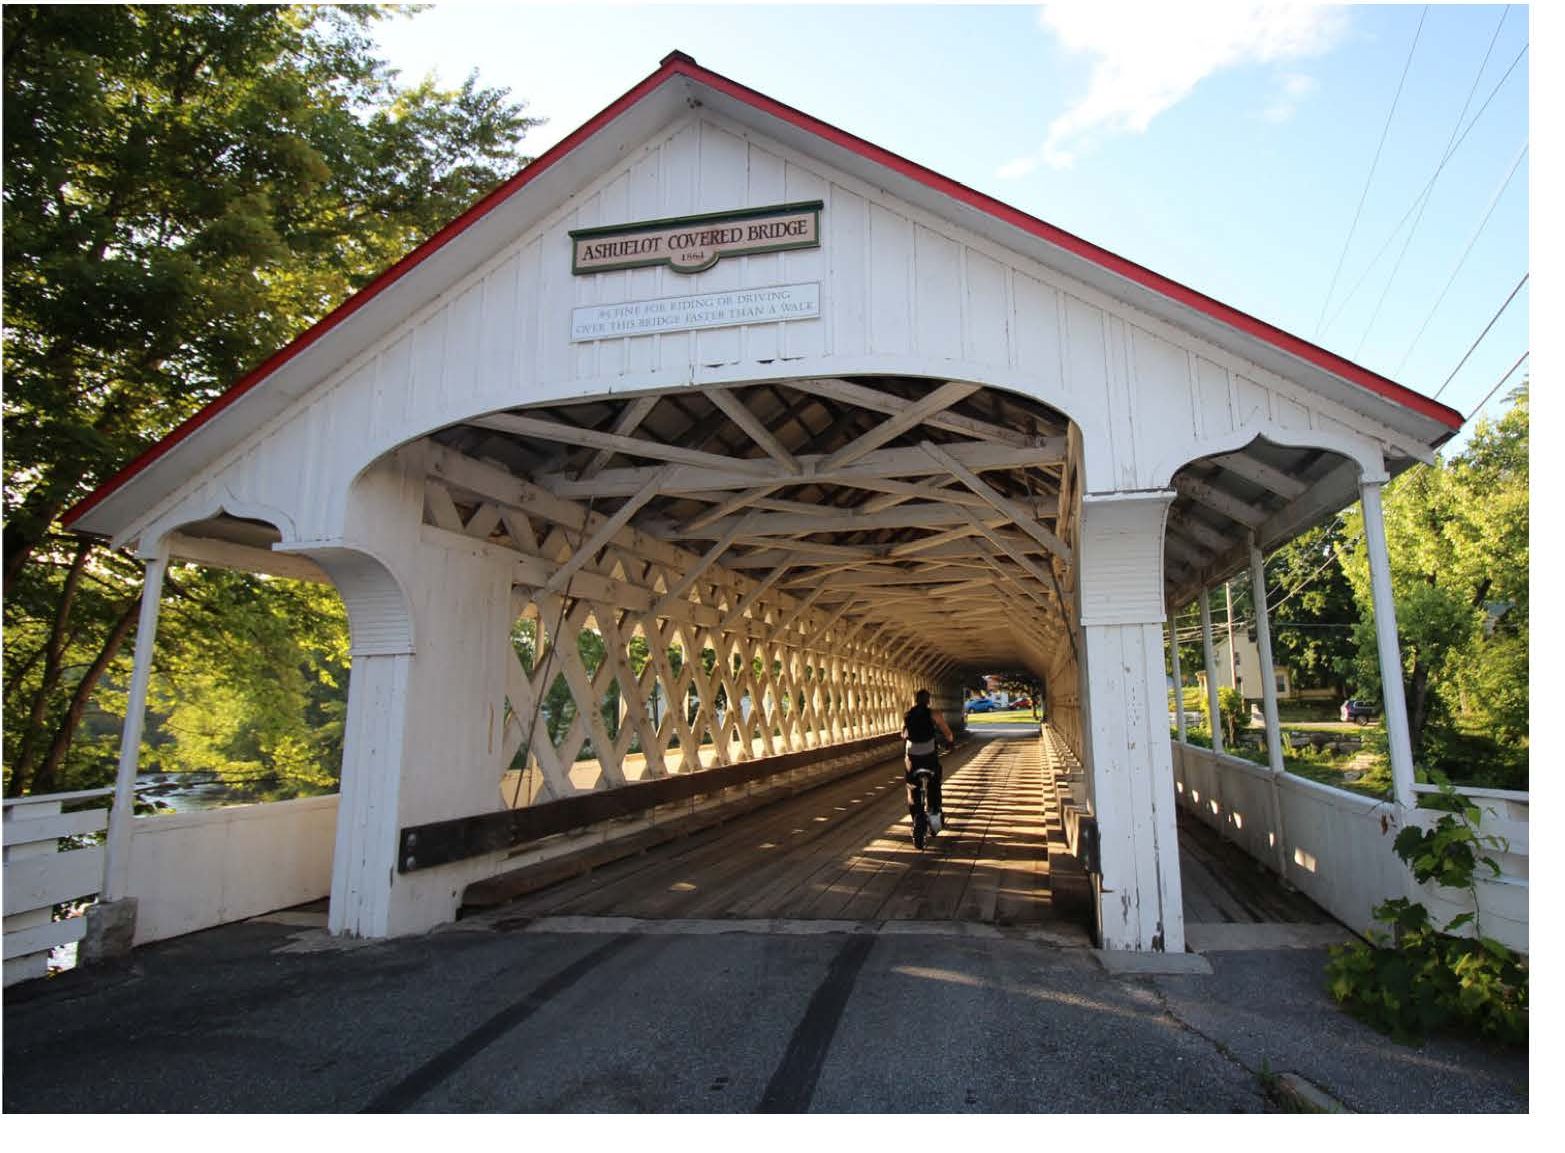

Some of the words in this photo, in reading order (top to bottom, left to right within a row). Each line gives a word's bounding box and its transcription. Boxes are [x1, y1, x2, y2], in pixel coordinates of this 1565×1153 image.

[582, 237, 662, 261] ASHUELOT
[668, 227, 743, 250] COVERED
[748, 219, 808, 241] BRIDGE
[736, 290, 791, 305] DRIVING
[728, 306, 764, 320] THAN
[768, 304, 777, 316] A
[780, 300, 814, 314] WALK
